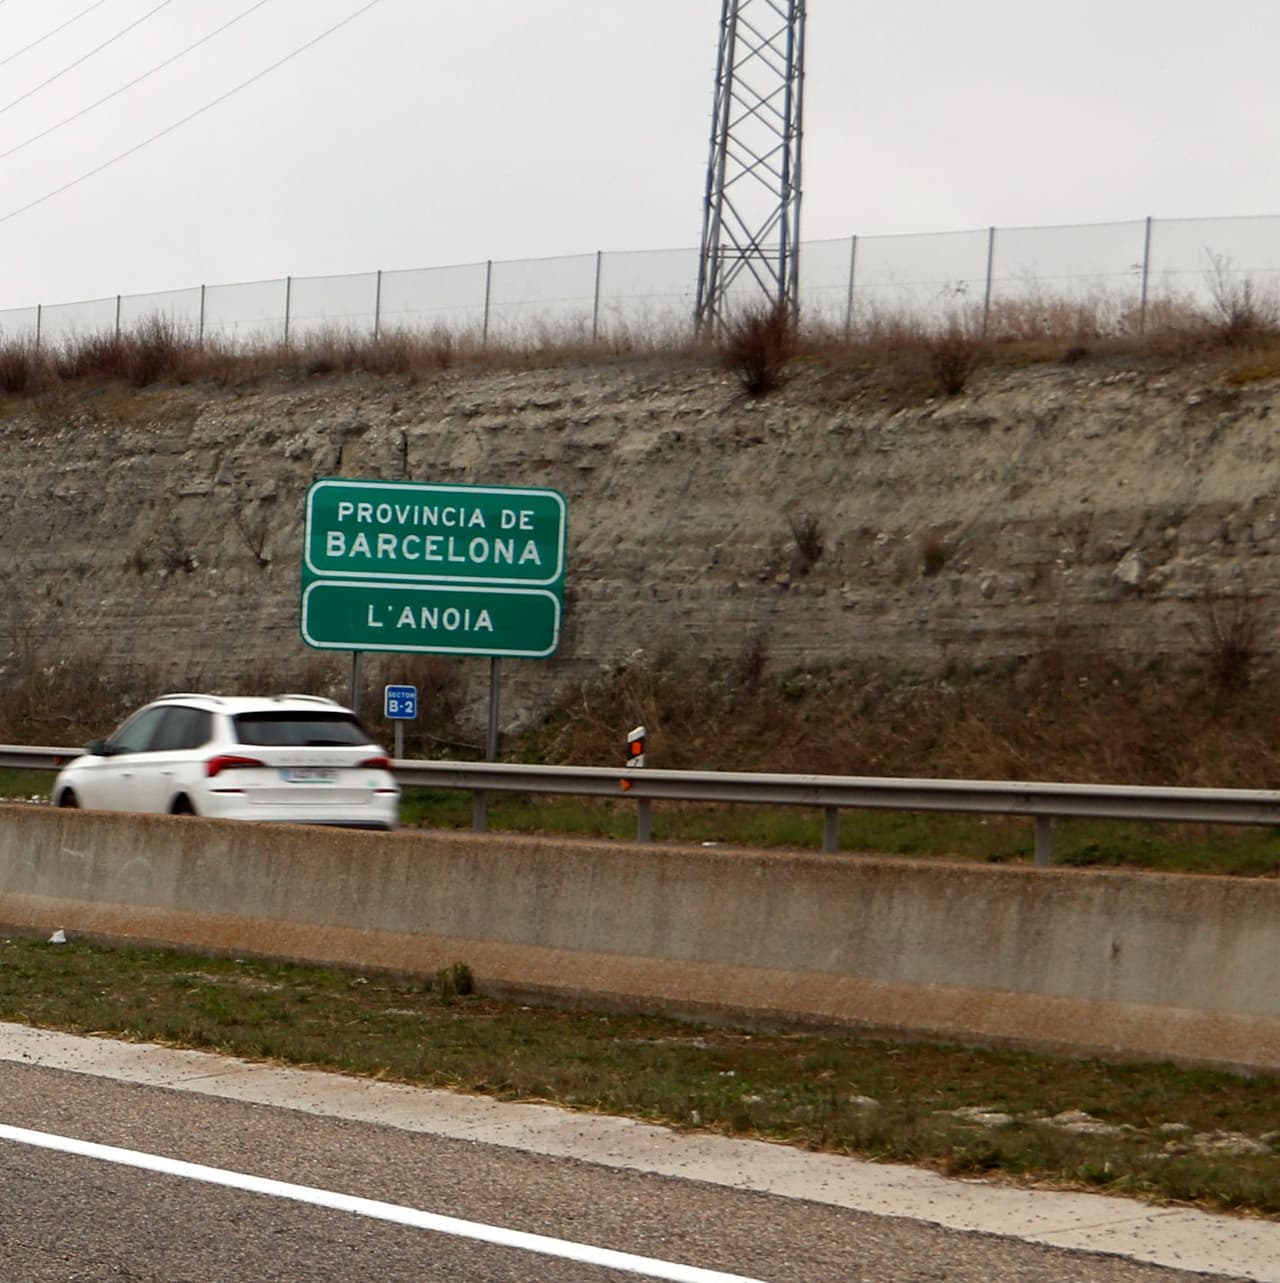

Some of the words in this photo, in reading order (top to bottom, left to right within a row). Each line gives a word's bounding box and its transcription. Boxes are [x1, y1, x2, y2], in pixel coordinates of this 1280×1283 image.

[337, 502, 486, 528] PROVINCIA
[500, 509, 535, 530] DE
[326, 531, 541, 565] BARCELONA
[367, 604, 494, 632] L'ANOIA
[389, 700, 414, 713] B-2
